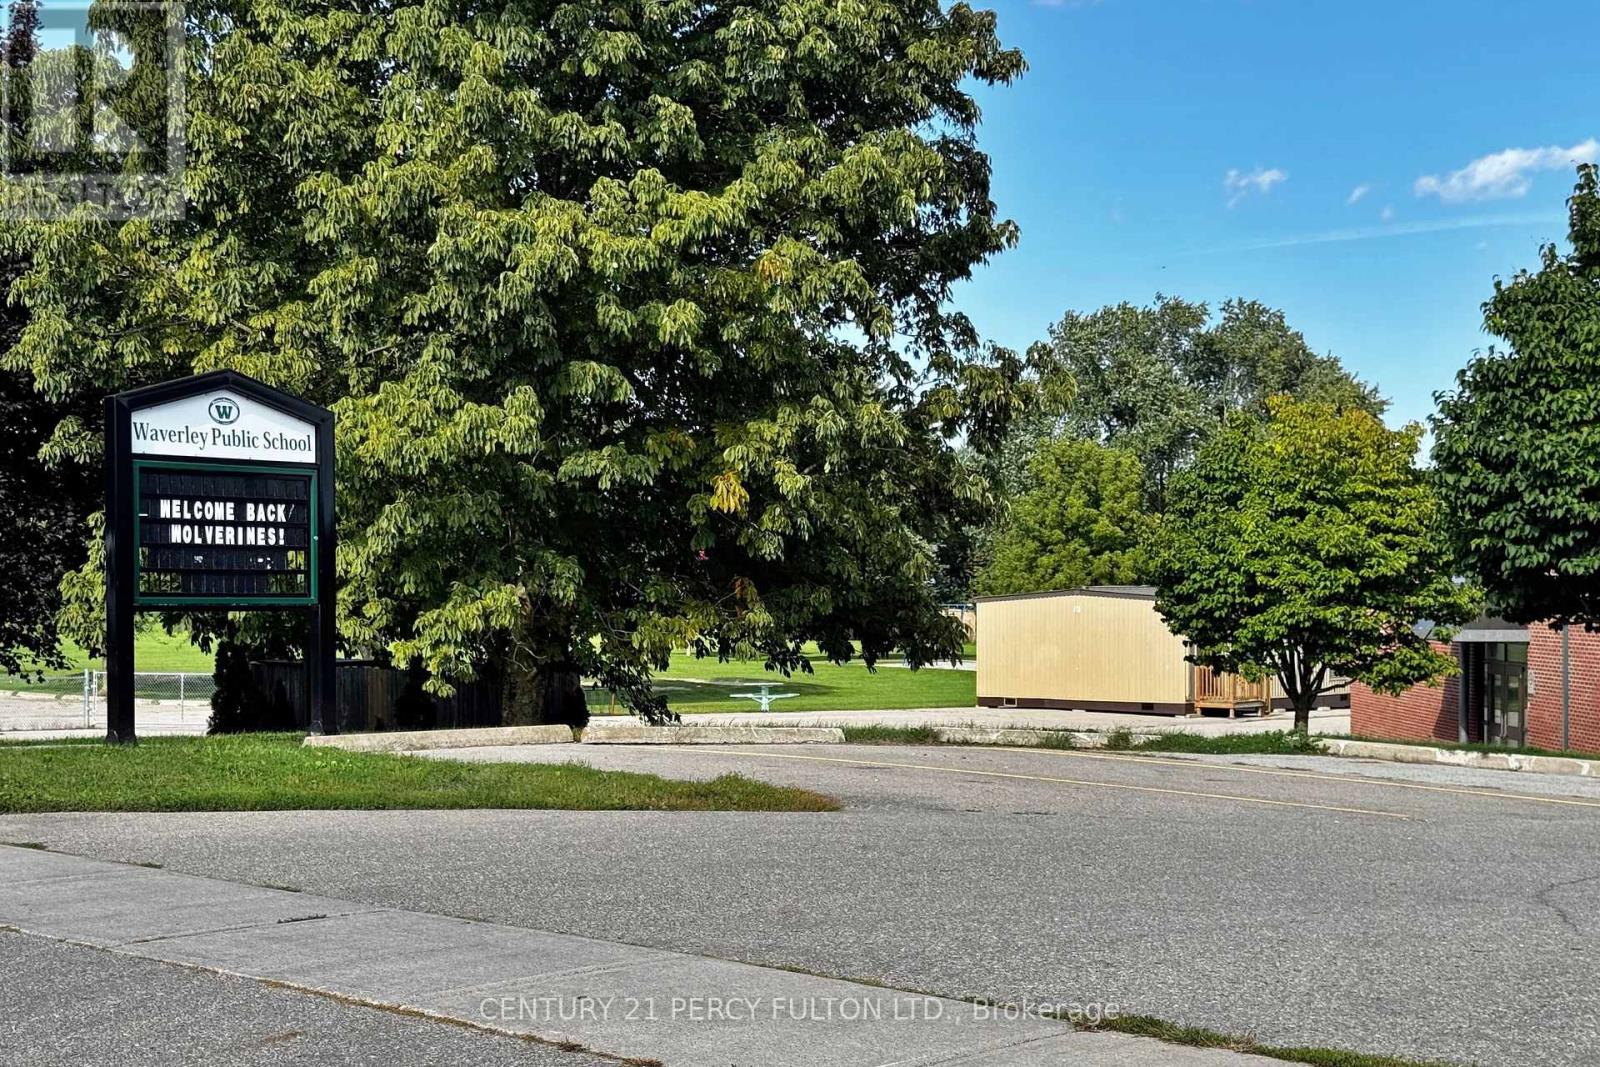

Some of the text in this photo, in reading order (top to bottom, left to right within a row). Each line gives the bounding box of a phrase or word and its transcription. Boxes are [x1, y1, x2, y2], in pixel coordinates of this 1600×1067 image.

[215, 405, 233, 419] W
[133, 422, 312, 452] Waverley Public School
[160, 499, 287, 523] WELCOME BACK
[170, 524, 285, 546] WOLVERINES!
